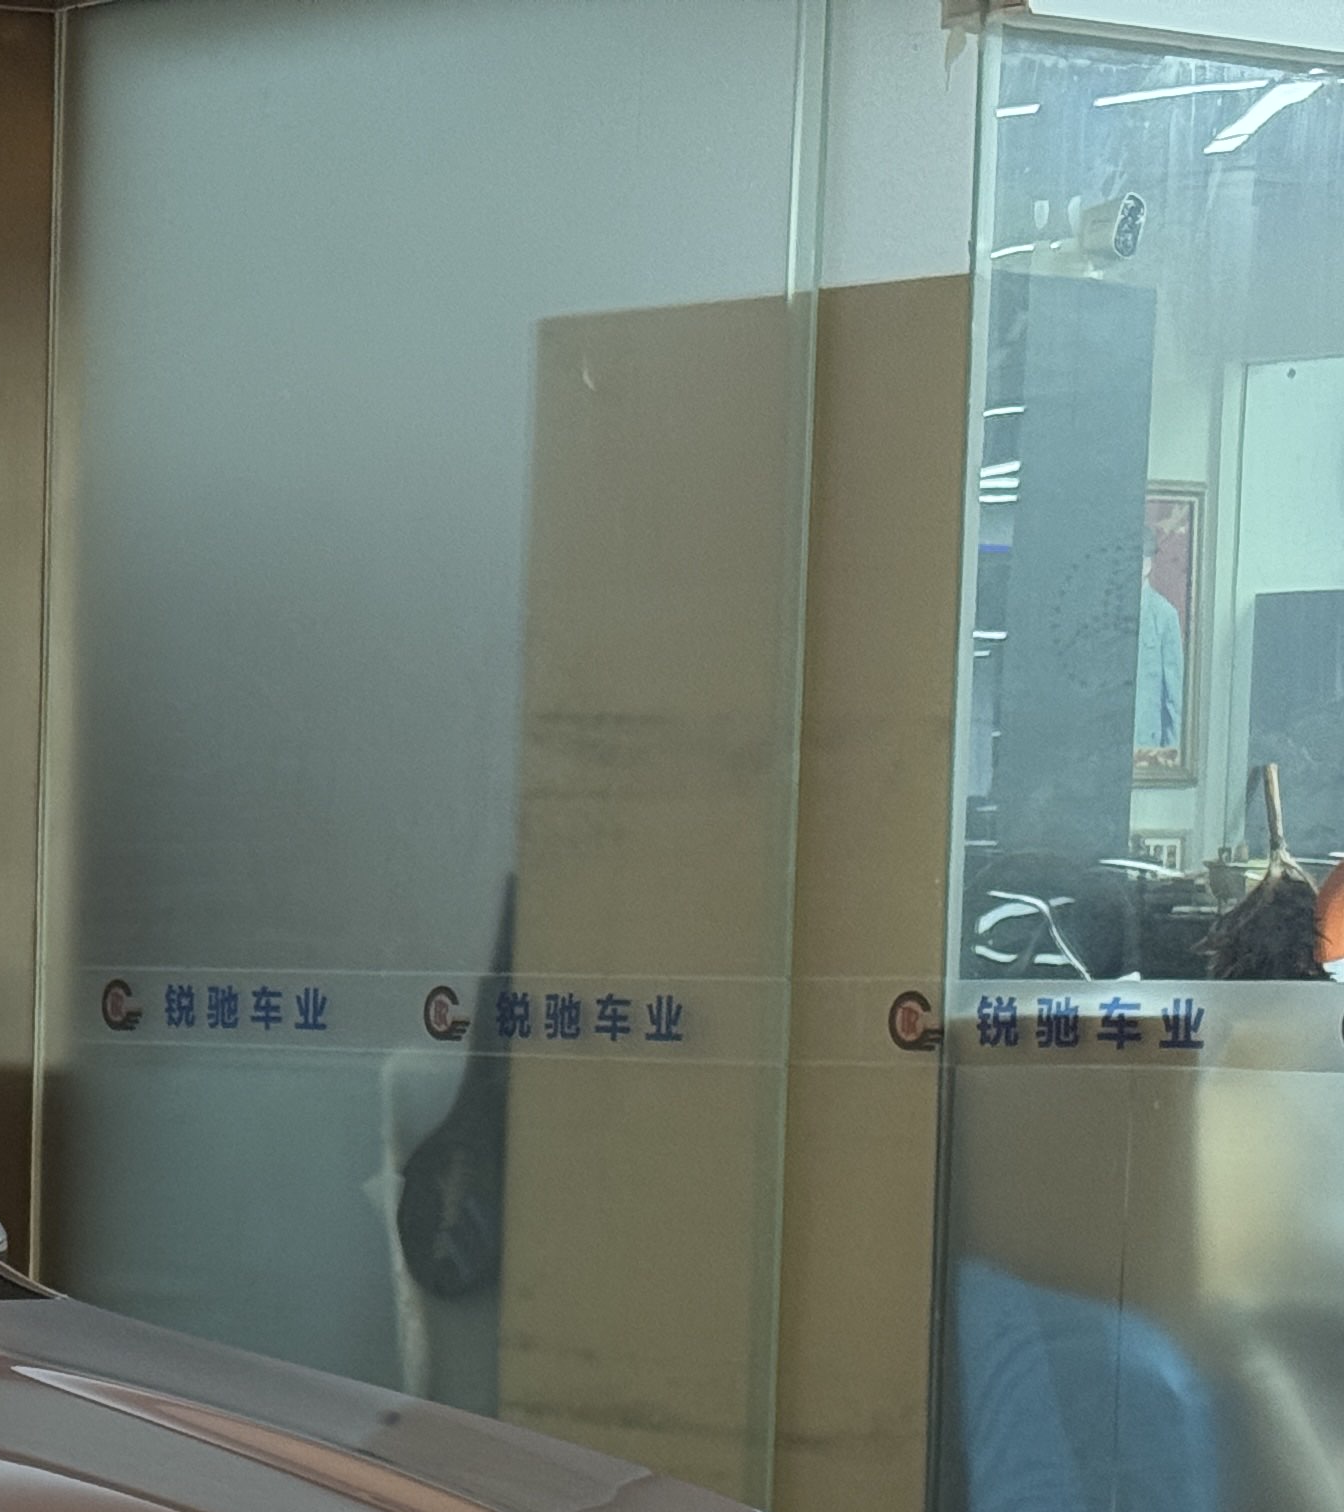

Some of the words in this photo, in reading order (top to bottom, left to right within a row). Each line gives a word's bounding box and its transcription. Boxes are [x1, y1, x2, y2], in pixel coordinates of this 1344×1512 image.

[164, 983, 328, 1031] 锐驰车业
[496, 991, 683, 1042] 锐驰车业
[976, 995, 1205, 1050] 锐驰车业
